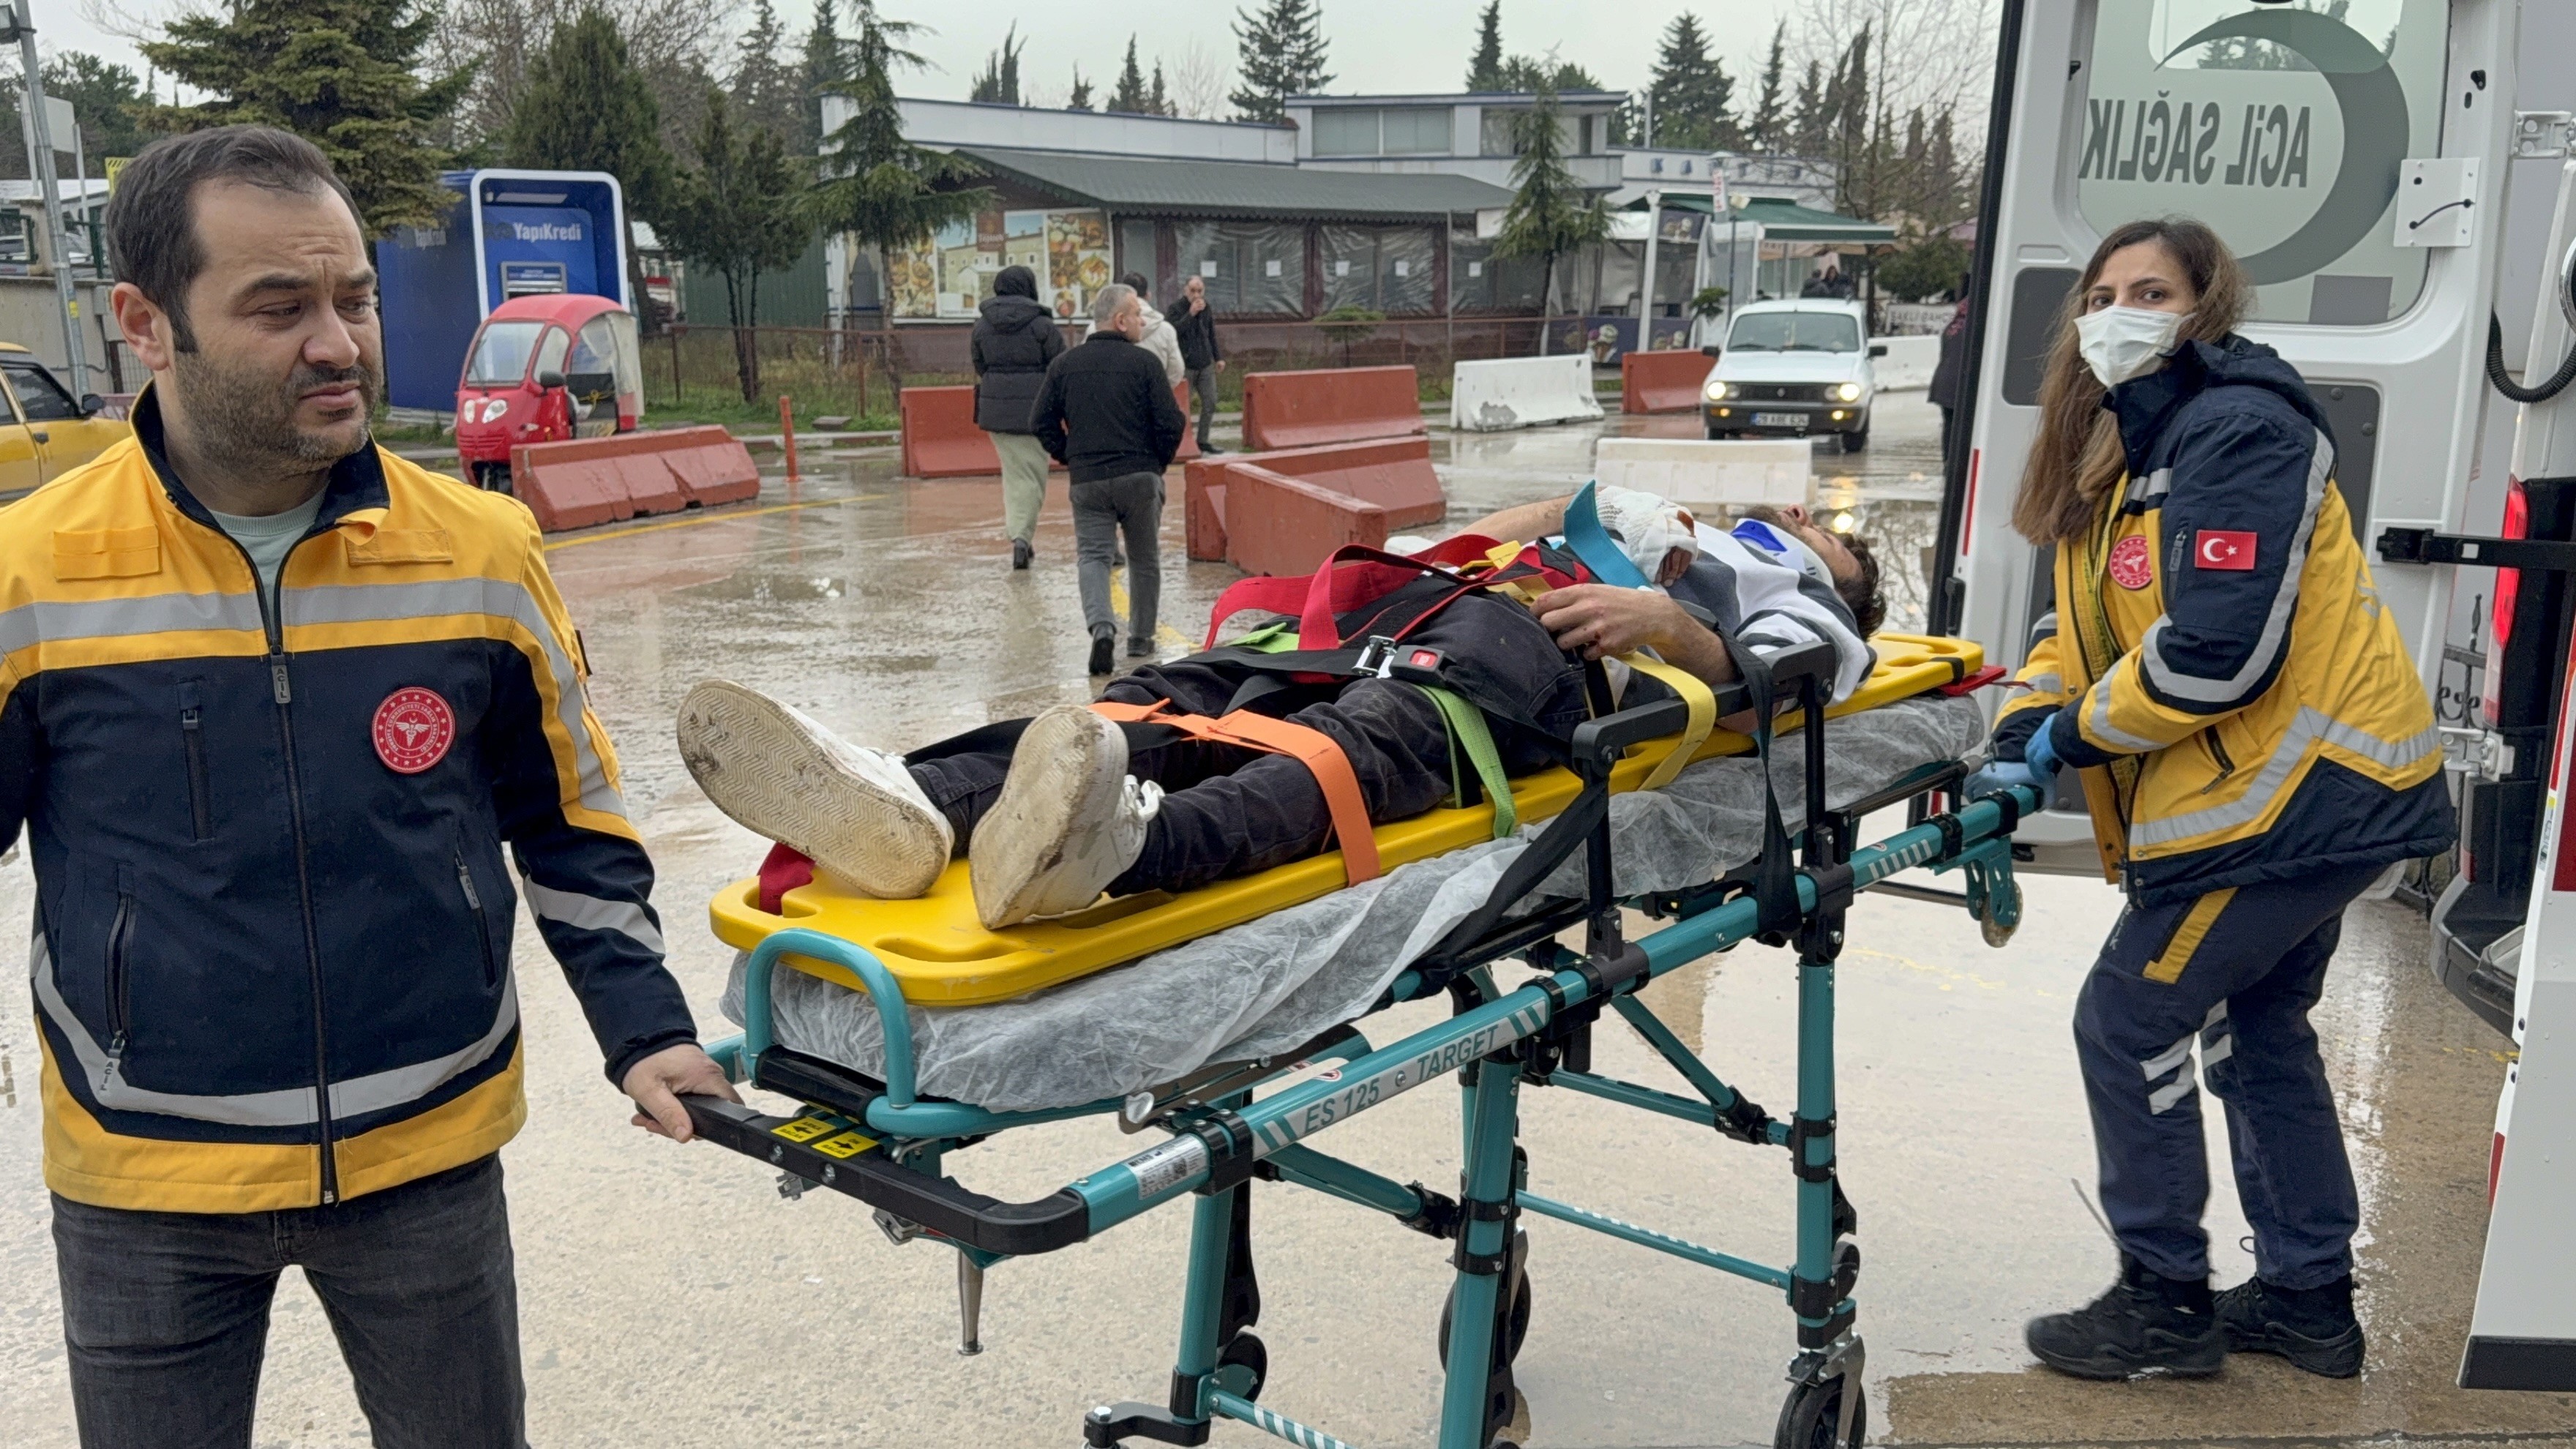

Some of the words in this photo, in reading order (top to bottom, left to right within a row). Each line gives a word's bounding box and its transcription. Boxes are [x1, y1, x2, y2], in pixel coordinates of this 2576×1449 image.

[513, 222, 582, 242] YapıKredi
[1303, 1098, 1336, 1134] ES
[1344, 1077, 1381, 1116] 125
[1417, 1025, 1499, 1082] TARGET
